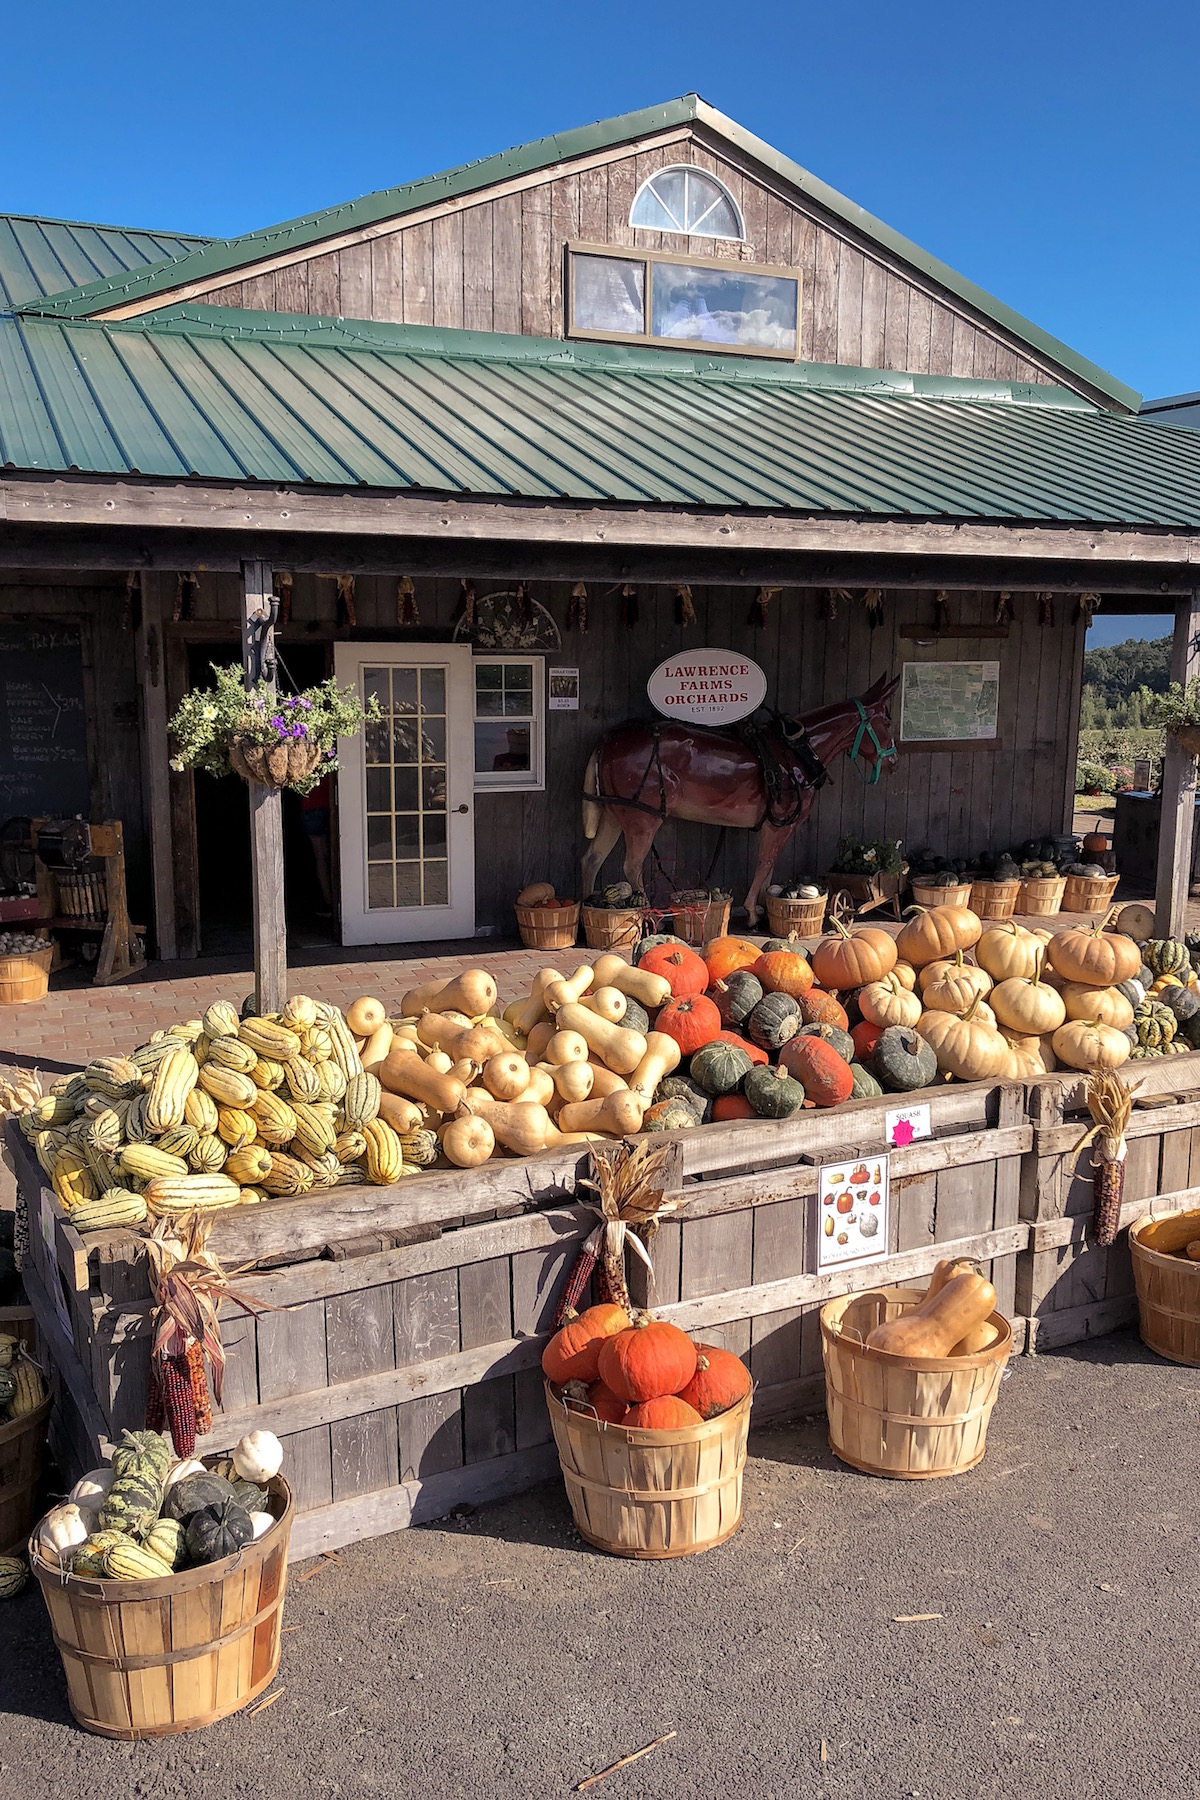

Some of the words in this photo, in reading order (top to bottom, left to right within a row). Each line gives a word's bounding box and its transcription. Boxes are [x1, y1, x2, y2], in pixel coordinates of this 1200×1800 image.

[664, 665, 749, 678] LAWRENCE
[680, 680, 732, 691] FARMS
[664, 693, 748, 705] ORCHARDS
[896, 1110, 921, 1121] SQUASH
